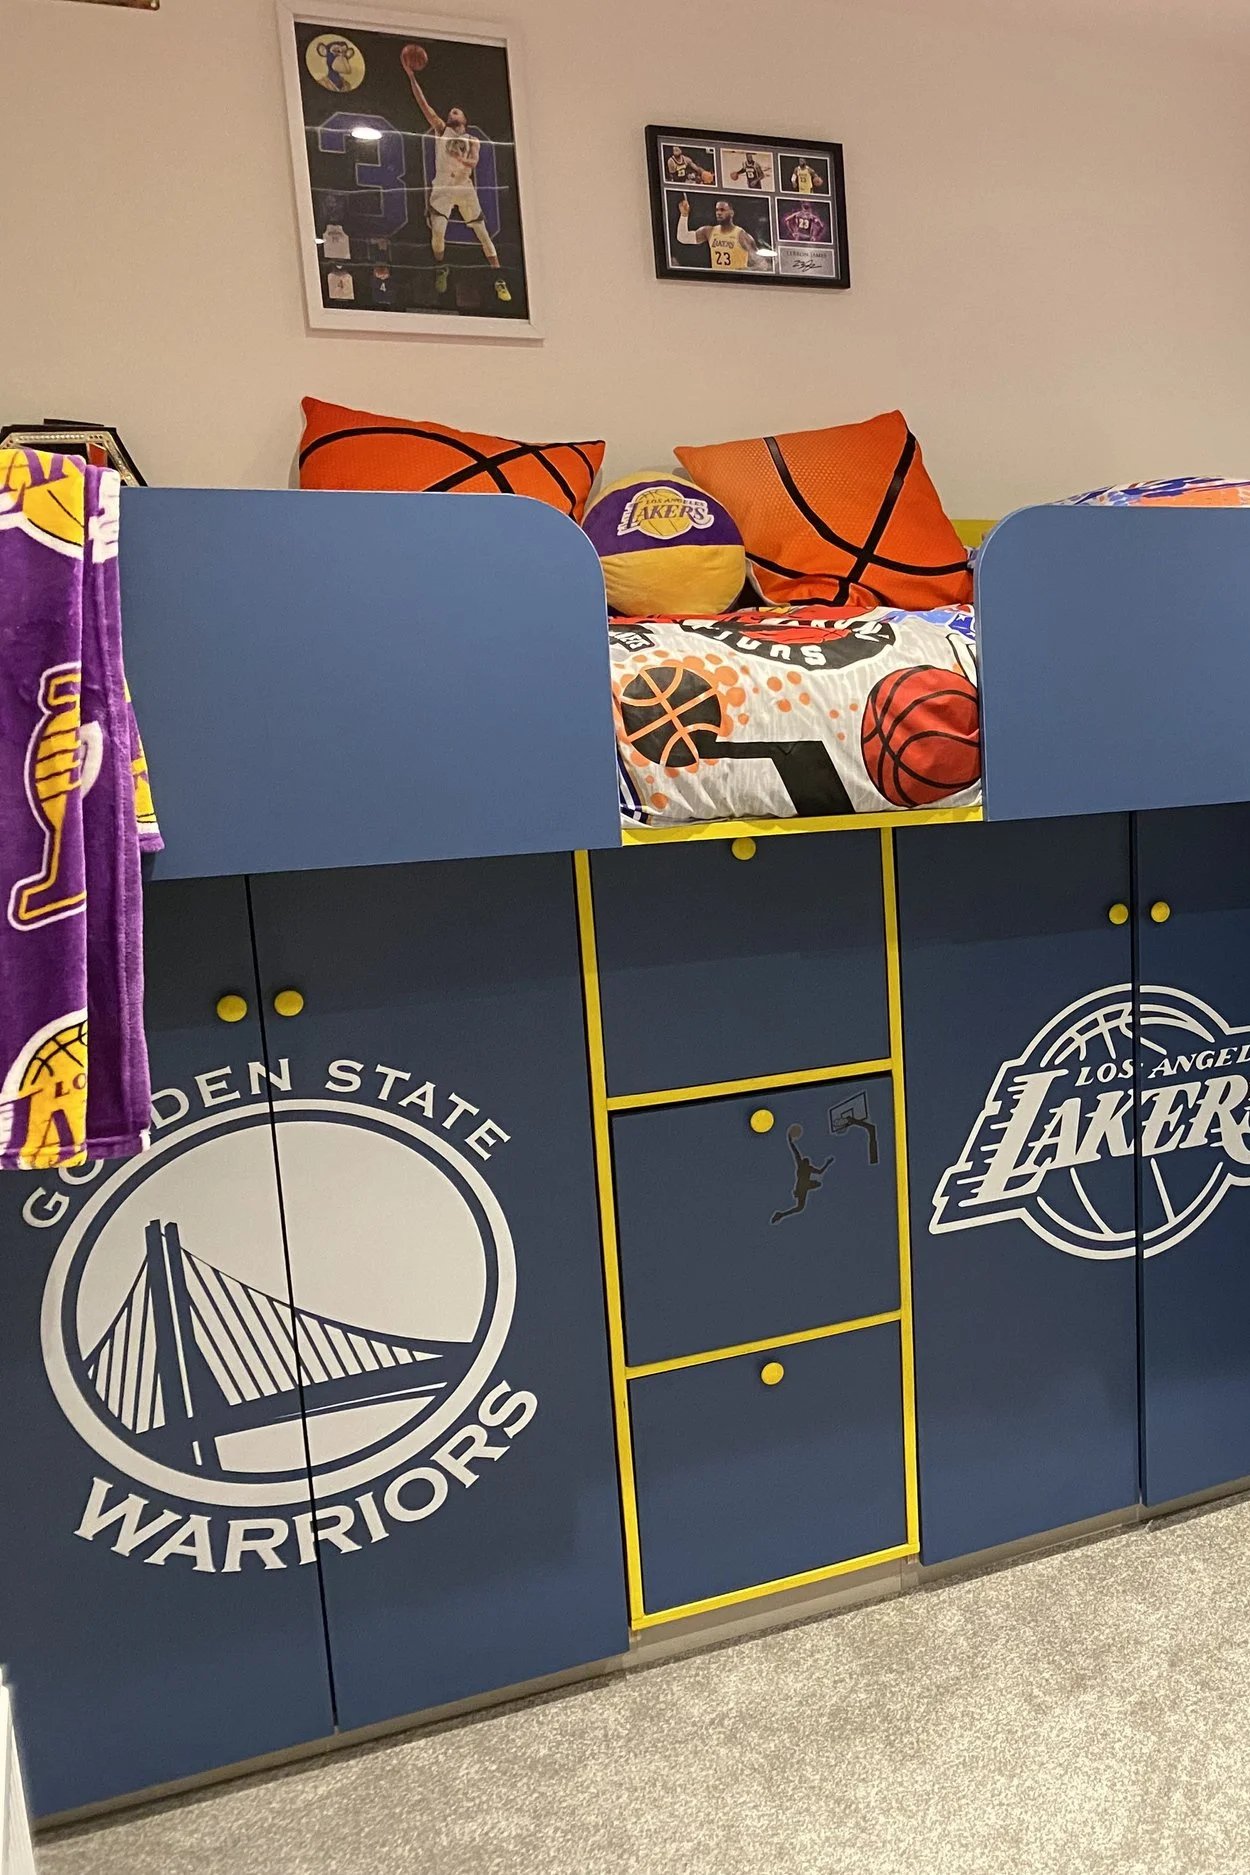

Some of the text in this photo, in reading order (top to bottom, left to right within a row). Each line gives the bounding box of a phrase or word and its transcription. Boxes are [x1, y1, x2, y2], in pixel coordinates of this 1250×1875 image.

[798, 218, 810, 229] 23
[715, 251, 731, 266] 23
[626, 503, 705, 530] LAKERS
[55, 1073, 87, 1098] LO
[1074, 1058, 1135, 1087] LOS
[325, 1058, 511, 1162] STATE
[74, 1380, 538, 1574] WARRIORS
